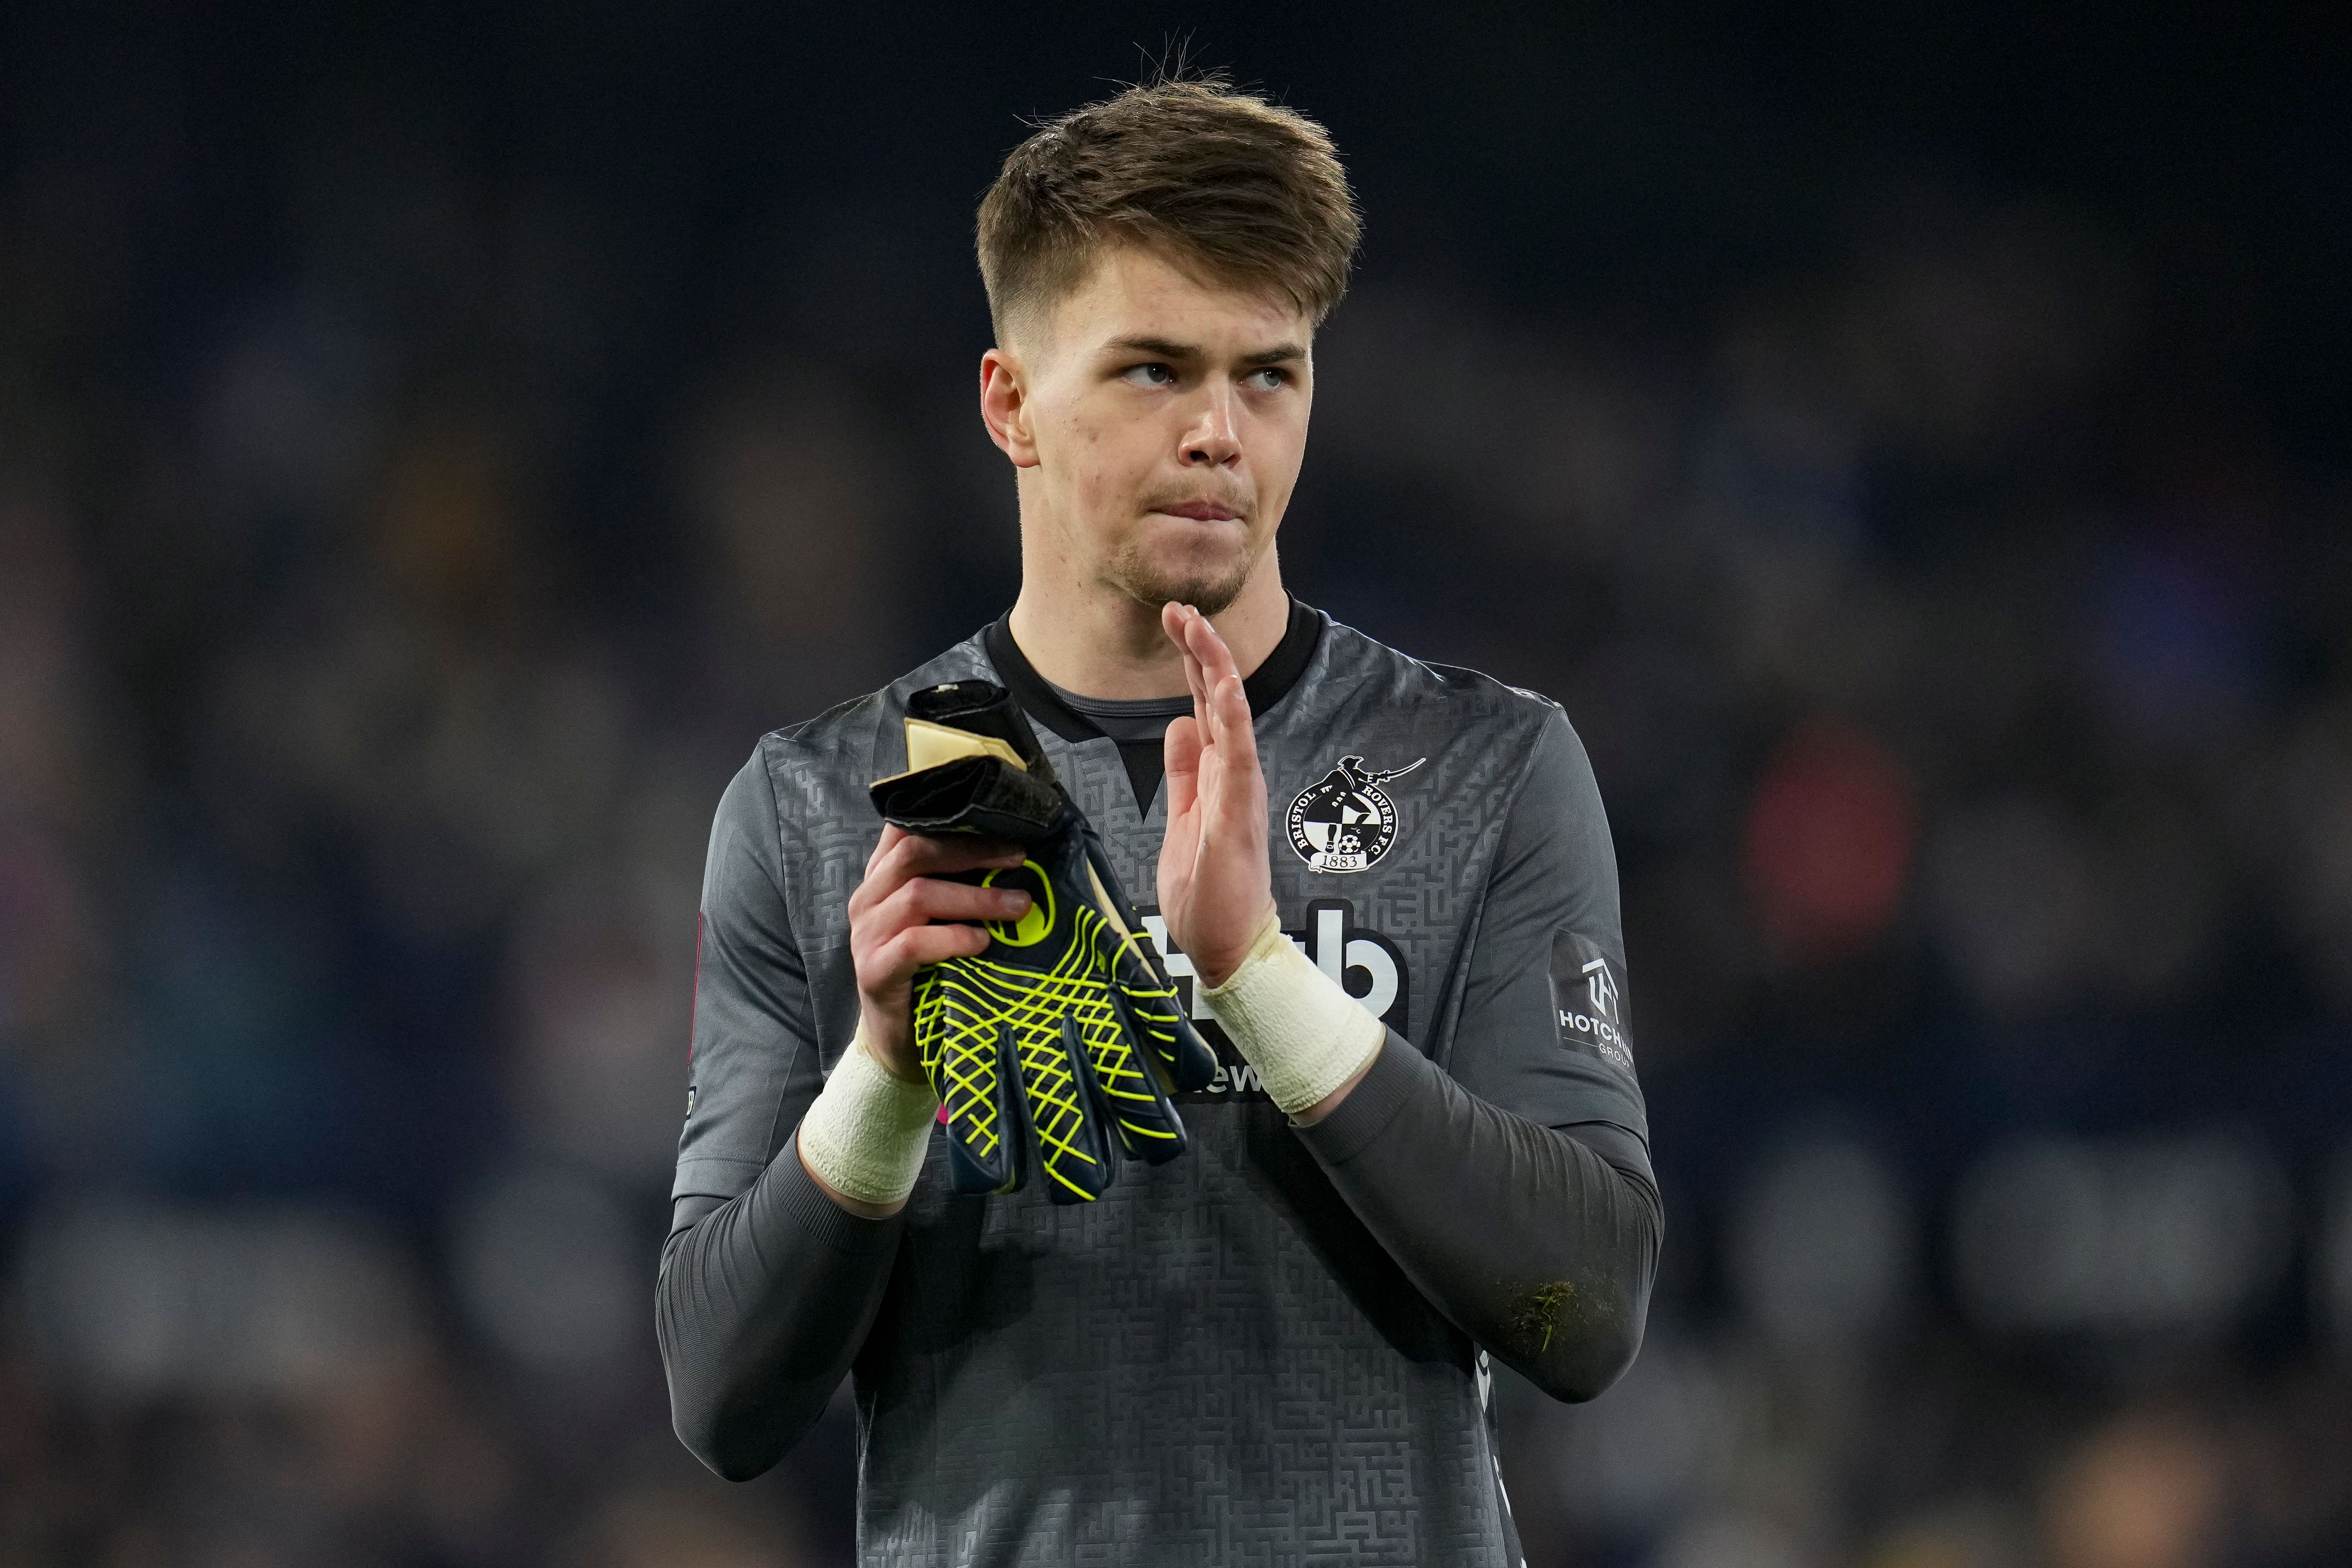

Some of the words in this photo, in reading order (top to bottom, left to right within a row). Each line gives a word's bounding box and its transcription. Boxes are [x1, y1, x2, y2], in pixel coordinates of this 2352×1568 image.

[1291, 791, 1316, 849] BRISTOL
[1361, 785, 1393, 834] ROVERS
[1322, 855, 1357, 868] 1883
[1599, 1043, 1630, 1069] GROUP
